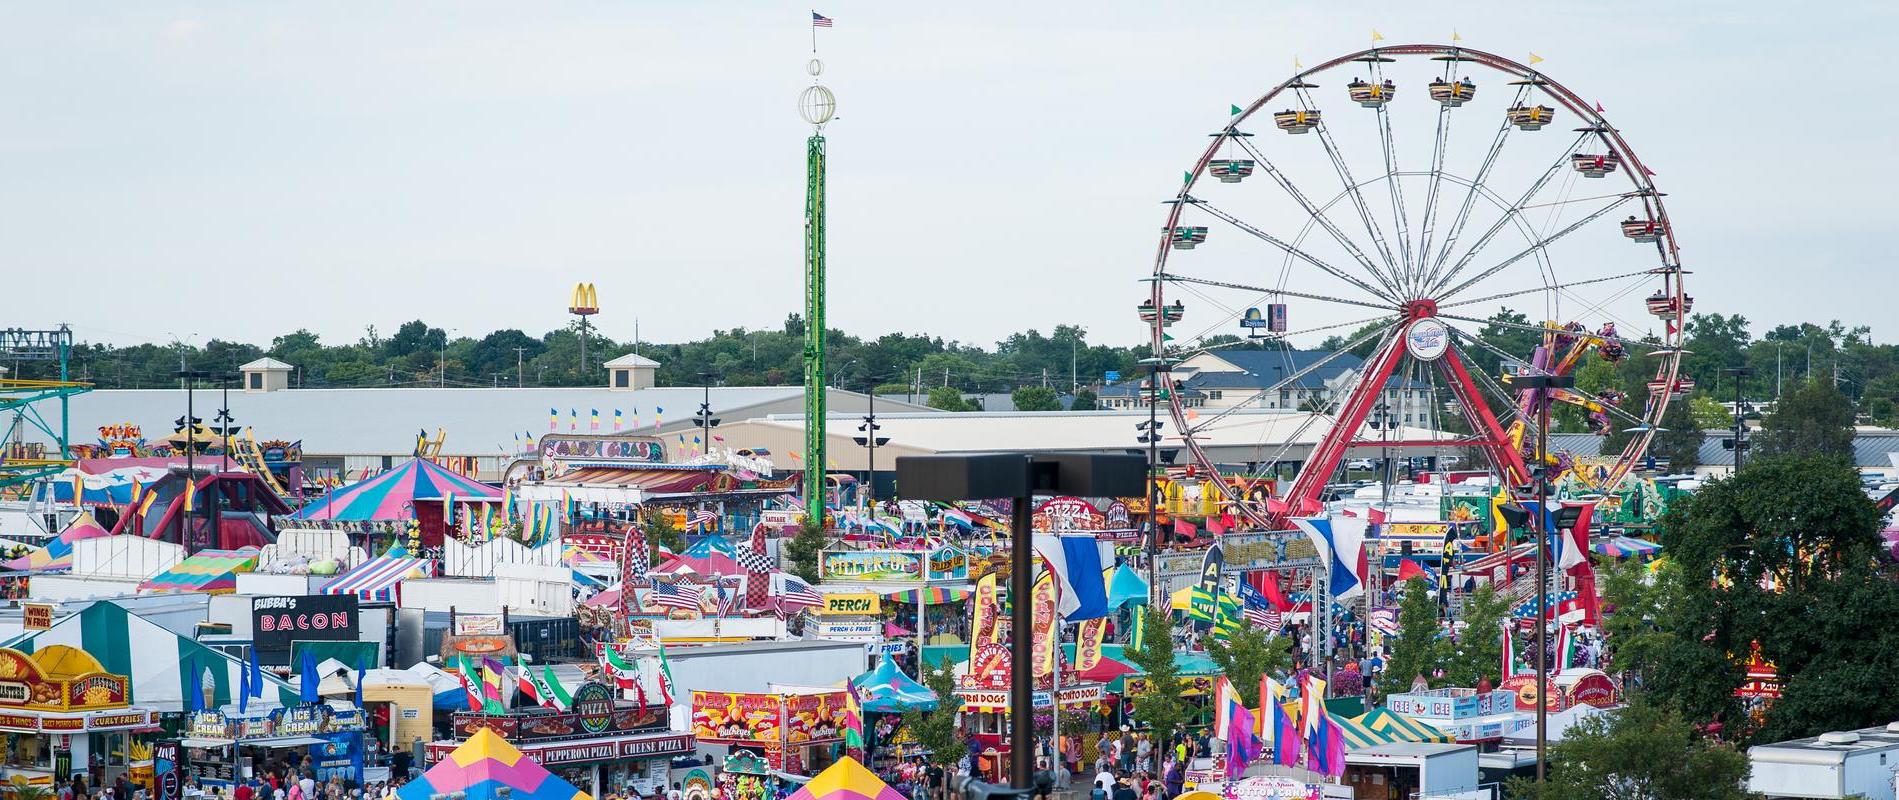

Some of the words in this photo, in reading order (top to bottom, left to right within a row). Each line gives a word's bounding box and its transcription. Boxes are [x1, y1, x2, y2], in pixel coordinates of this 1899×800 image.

[555, 440, 604, 456] MARDI
[606, 441, 650, 457] GRAS
[1043, 503, 1092, 520] PIZZA
[953, 555, 964, 567] UP
[254, 597, 297, 611] BUBBA'S
[829, 599, 871, 611] PERCH
[27, 607, 49, 617] WINGS
[33, 618, 50, 627] FRIES
[260, 612, 349, 631] BACON
[881, 643, 903, 653] FRIES
[89, 676, 121, 695] MASTERS
[980, 694, 1006, 703] DOGS
[1056, 691, 1081, 701] RONTO
[1082, 688, 1099, 698] DOGS
[693, 693, 733, 709] DEEP
[736, 696, 779, 711] FRIED
[581, 702, 610, 715] PIZZA
[95, 714, 119, 726] CURLY
[120, 713, 141, 724] FRIES
[203, 713, 217, 722] ICE
[293, 710, 310, 720] ICE
[13, 716, 33, 727] THINGS
[285, 722, 318, 733] CREAM
[195, 724, 224, 735] CREAM
[720, 726, 751, 739] Buckeyes
[546, 745, 589, 762] PEPPERONI
[591, 744, 613, 758] PIZZA
[624, 742, 656, 755] CHEESE
[659, 739, 682, 753] PIZZA
[1230, 786, 1275, 796] COTTON
[1277, 786, 1314, 797] CANDY
